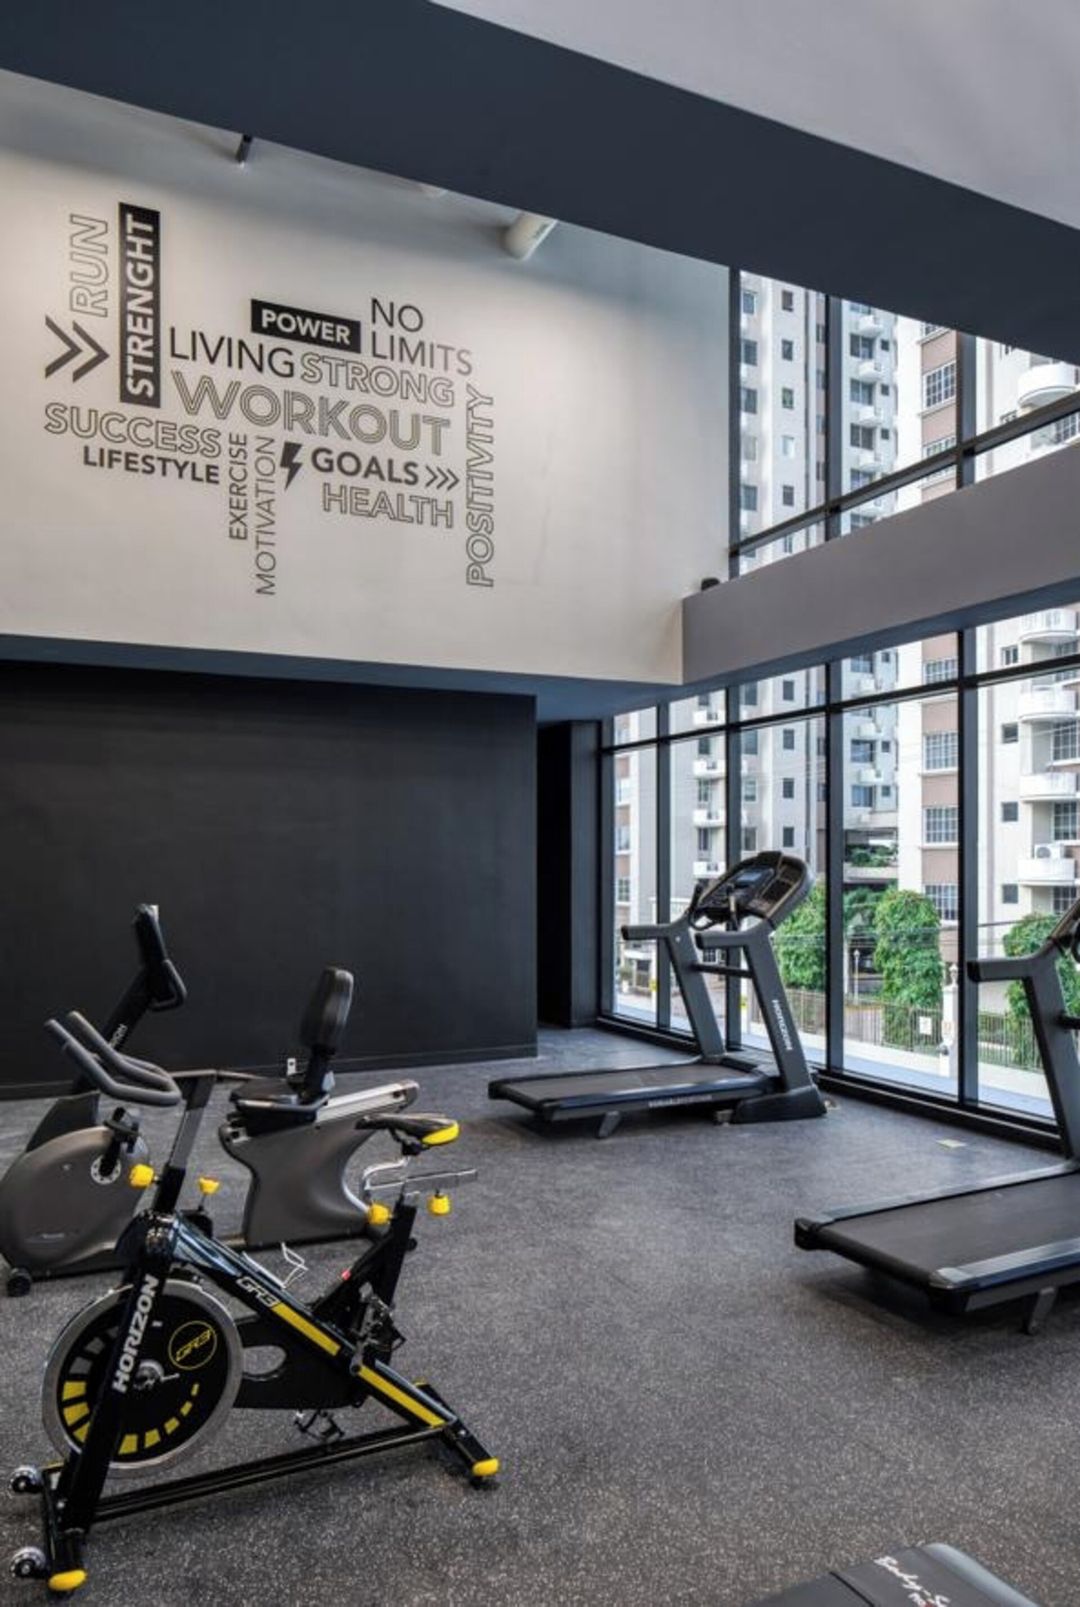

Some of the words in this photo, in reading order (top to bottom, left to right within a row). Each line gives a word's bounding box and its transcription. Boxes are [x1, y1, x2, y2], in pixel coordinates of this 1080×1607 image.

[69, 213, 110, 318] RUN
[125, 212, 156, 398] STRENGHT
[261, 308, 351, 345] POWER
[371, 297, 424, 333] NO
[170, 326, 295, 378] LIVING
[301, 352, 455, 408] STRONG
[371, 330, 474, 376] LIMITS
[44, 402, 222, 458] SUCCESS
[171, 370, 452, 456] WORKOUT
[83, 445, 221, 485] LIFESTYLE
[229, 432, 248, 540] EXERCISE
[311, 447, 419, 486] GOALS
[466, 382, 495, 588] POSITIVITY
[254, 435, 277, 596] MOTIVATION
[322, 482, 454, 529] HEALTH
[112, 1273, 159, 1393] HORIZON
